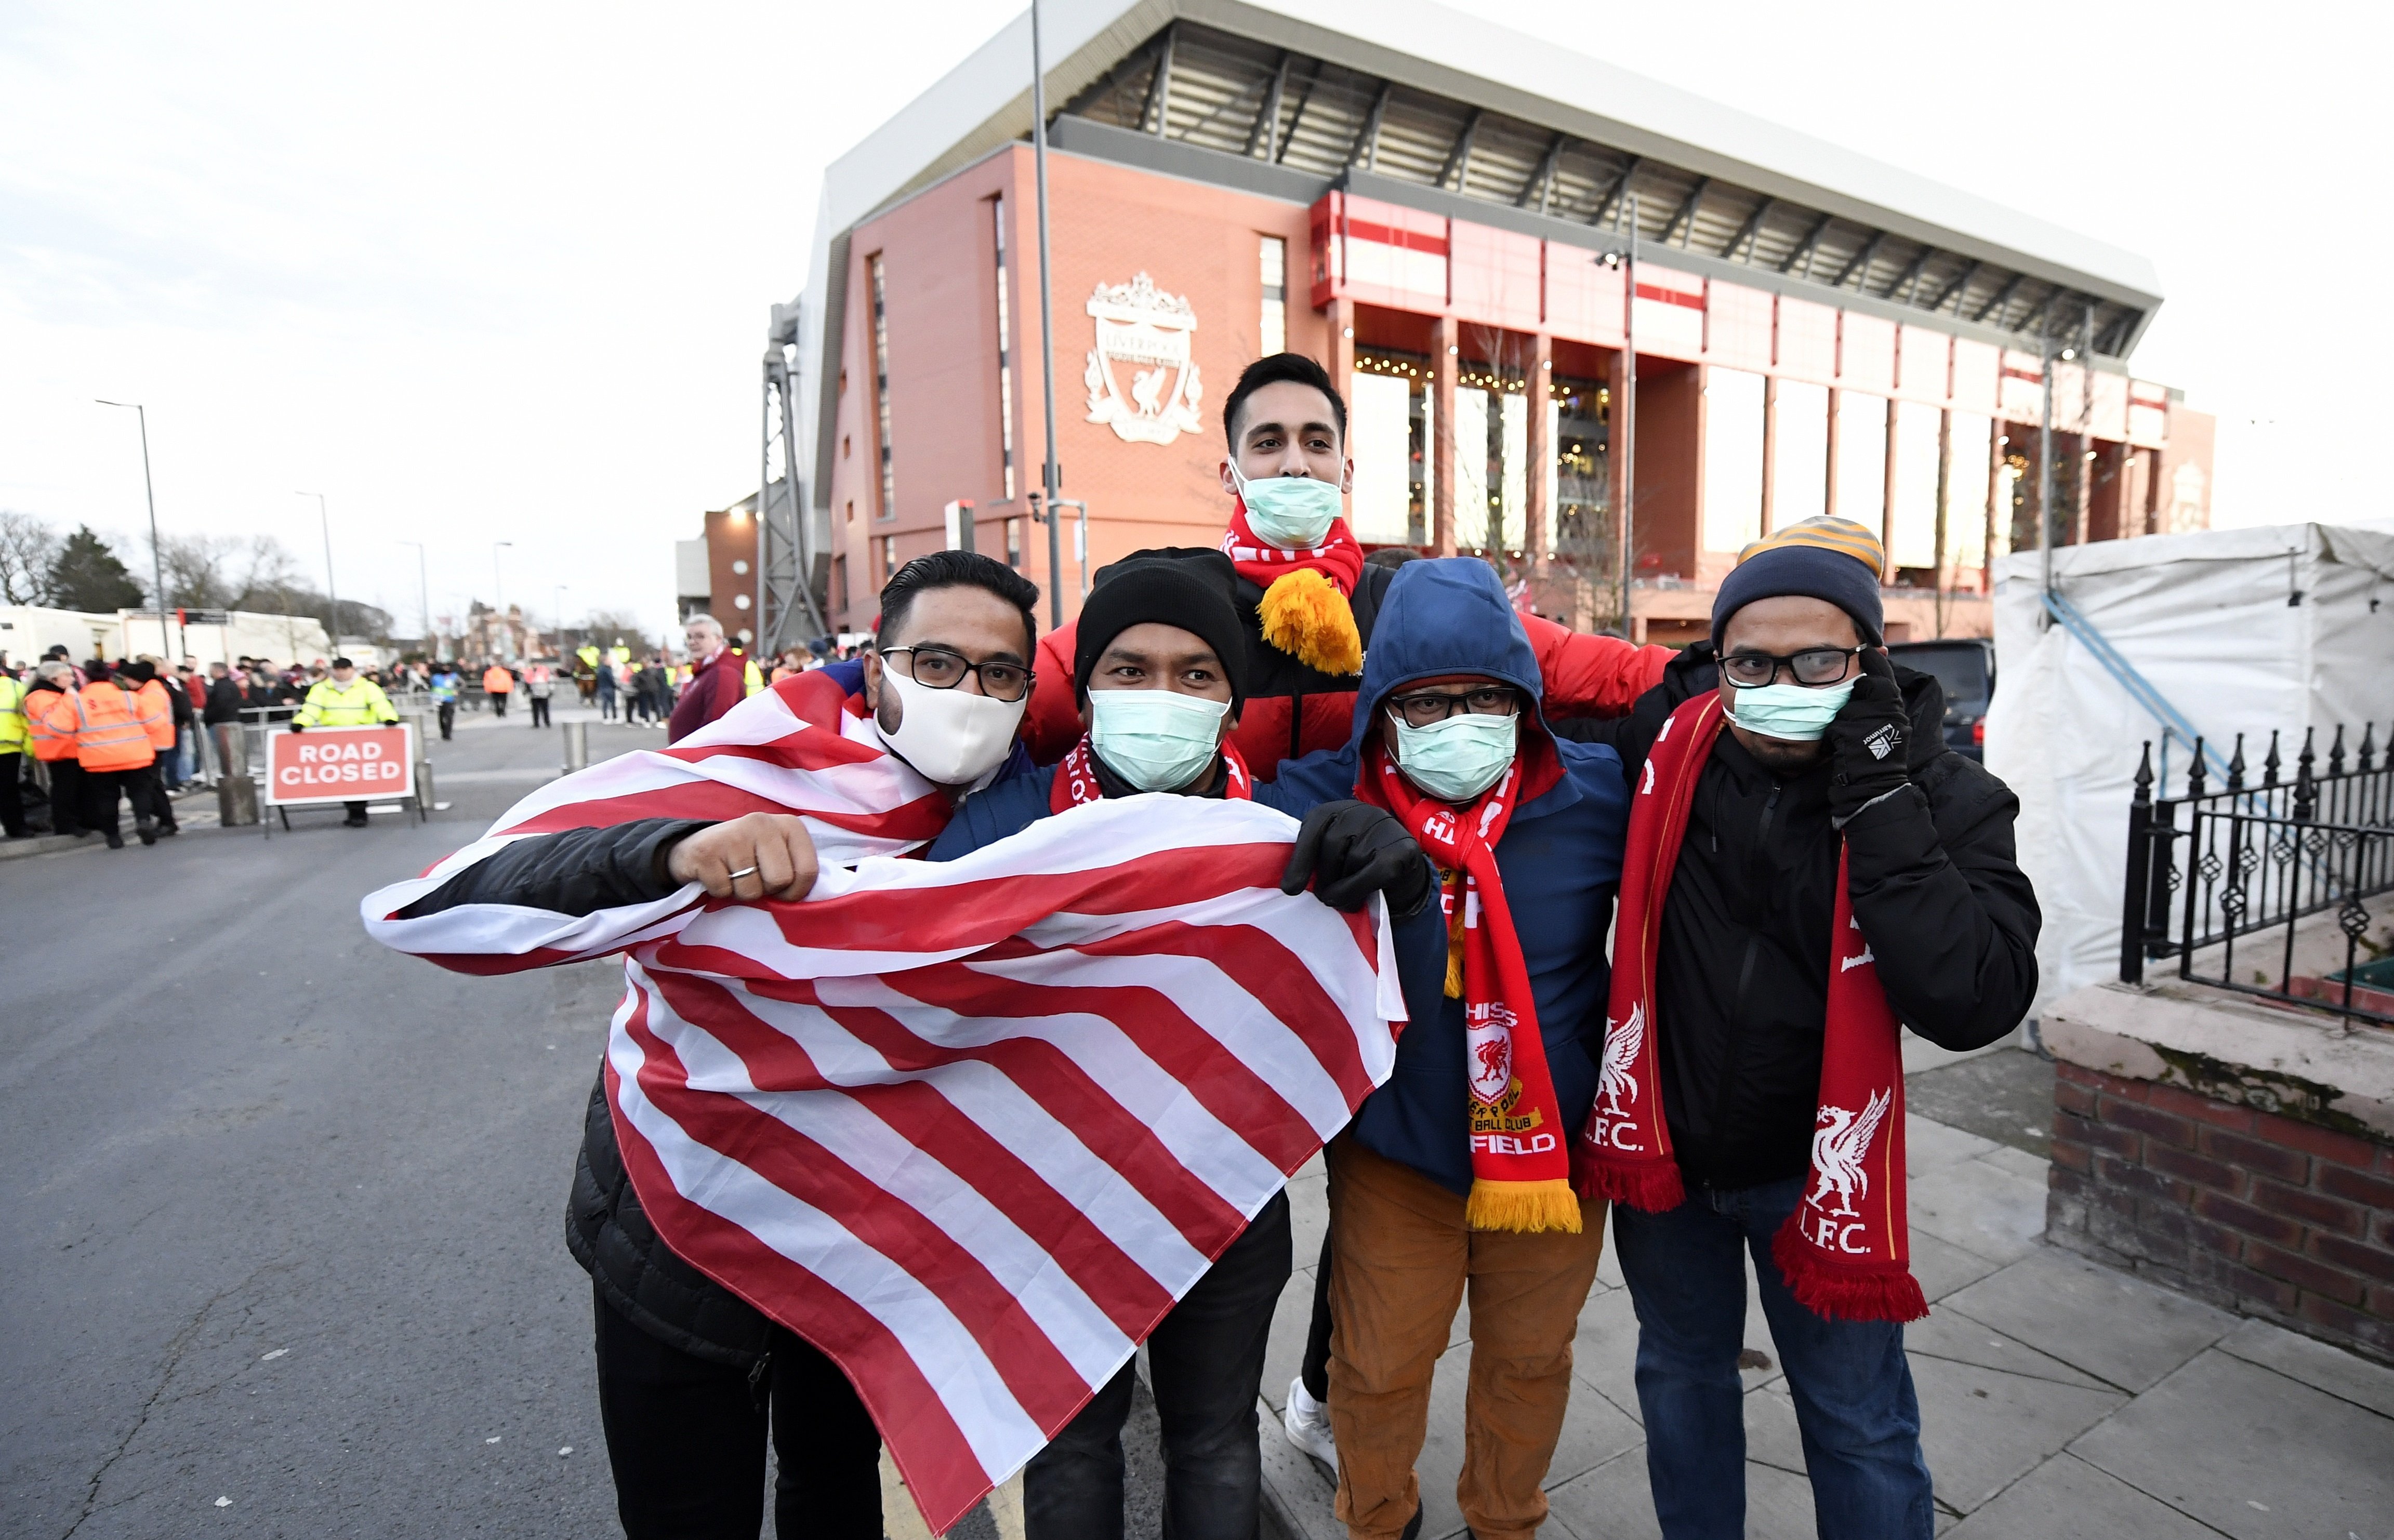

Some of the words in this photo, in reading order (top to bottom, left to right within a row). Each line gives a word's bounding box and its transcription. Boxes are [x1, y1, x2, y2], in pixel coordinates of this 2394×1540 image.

[1105, 333, 1180, 356] LIVERPOOL
[1863, 723, 1894, 745] karrimor
[299, 741, 382, 763] ROAD
[280, 761, 400, 785] CLOSED
[1505, 1117, 1531, 1131] CLUB
[1470, 1133, 1556, 1154] FIELD
